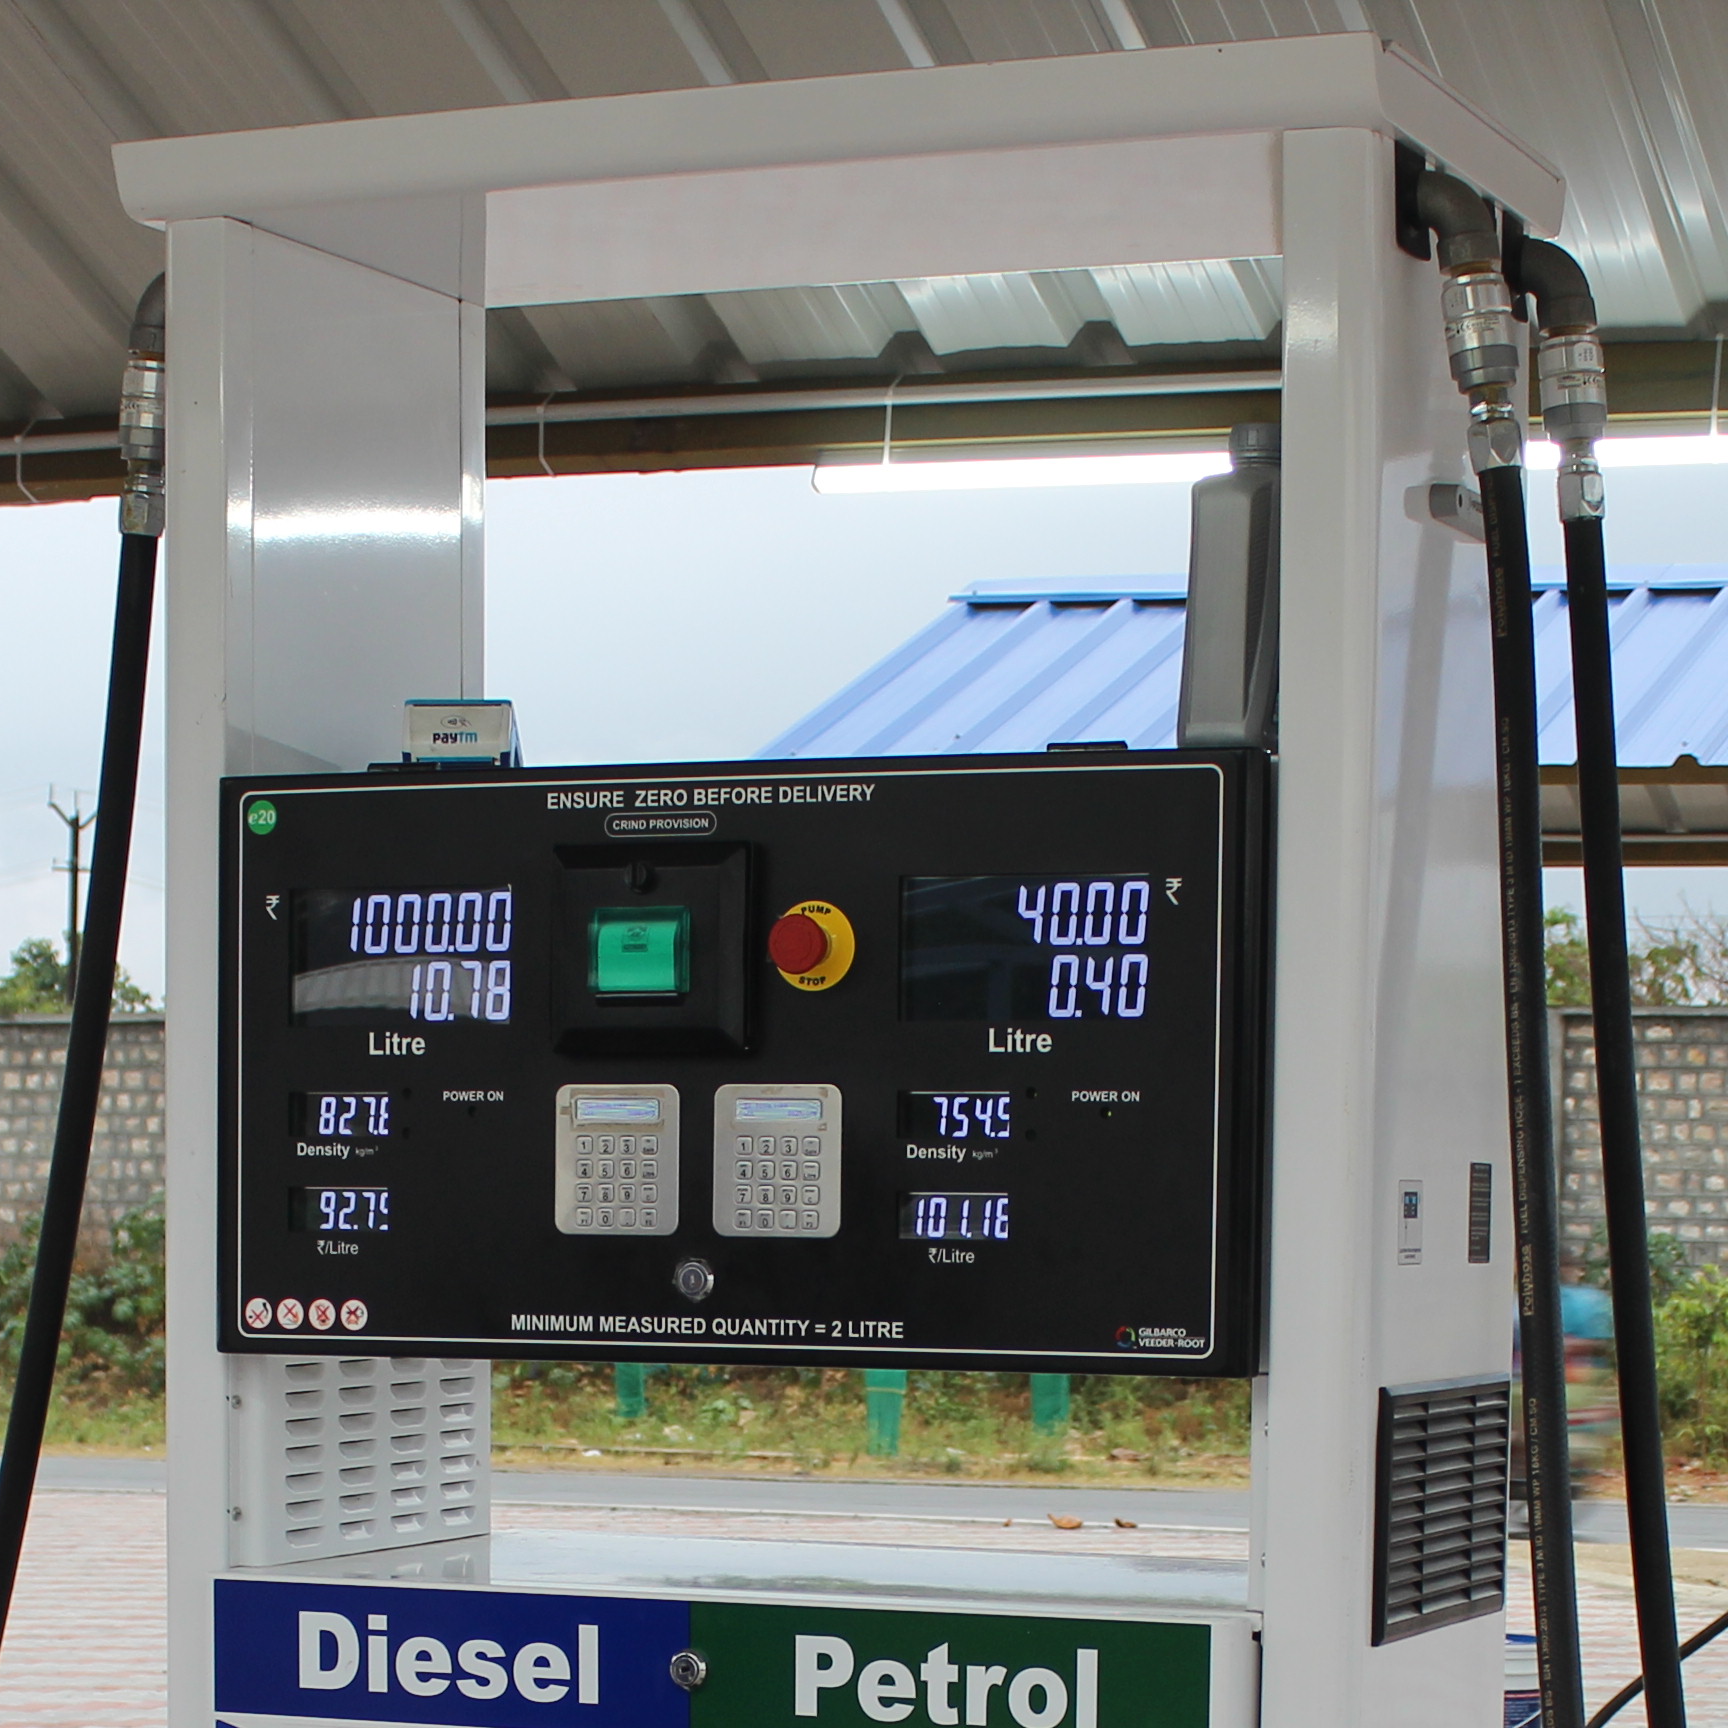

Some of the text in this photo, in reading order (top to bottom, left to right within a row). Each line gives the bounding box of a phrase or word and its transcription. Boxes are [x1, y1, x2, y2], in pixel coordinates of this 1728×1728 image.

[432, 731, 478, 746] paytm
[547, 784, 875, 809] ENSURE ZERO BEFORE DELIVERY
[248, 809, 276, 826] e20
[612, 818, 709, 830] CRIND PROVISION
[1165, 877, 1182, 905] ₹
[266, 895, 280, 920] ₹
[801, 905, 831, 915] PUMP
[1017, 881, 1150, 946] 40.00
[350, 891, 512, 954] 1000.00
[410, 960, 511, 1021] 10.78
[799, 976, 826, 986] STOP
[1048, 953, 1149, 1018] 0.40
[368, 1032, 426, 1056] Litre
[988, 1028, 1053, 1053] Litre
[442, 1091, 504, 1102] POWER ON
[1071, 1091, 1141, 1102] POWER ON
[296, 1142, 350, 1160] Density
[906, 1144, 967, 1163] Density
[316, 1240, 359, 1255] ₹/Litre
[928, 1248, 975, 1264] ₹/Litre
[511, 1314, 904, 1339] MINIMUM MEASURED QUANTITY = 2 LITRE
[1138, 1327, 1186, 1337] GILBARCO
[297, 1610, 600, 1707] Diesel
